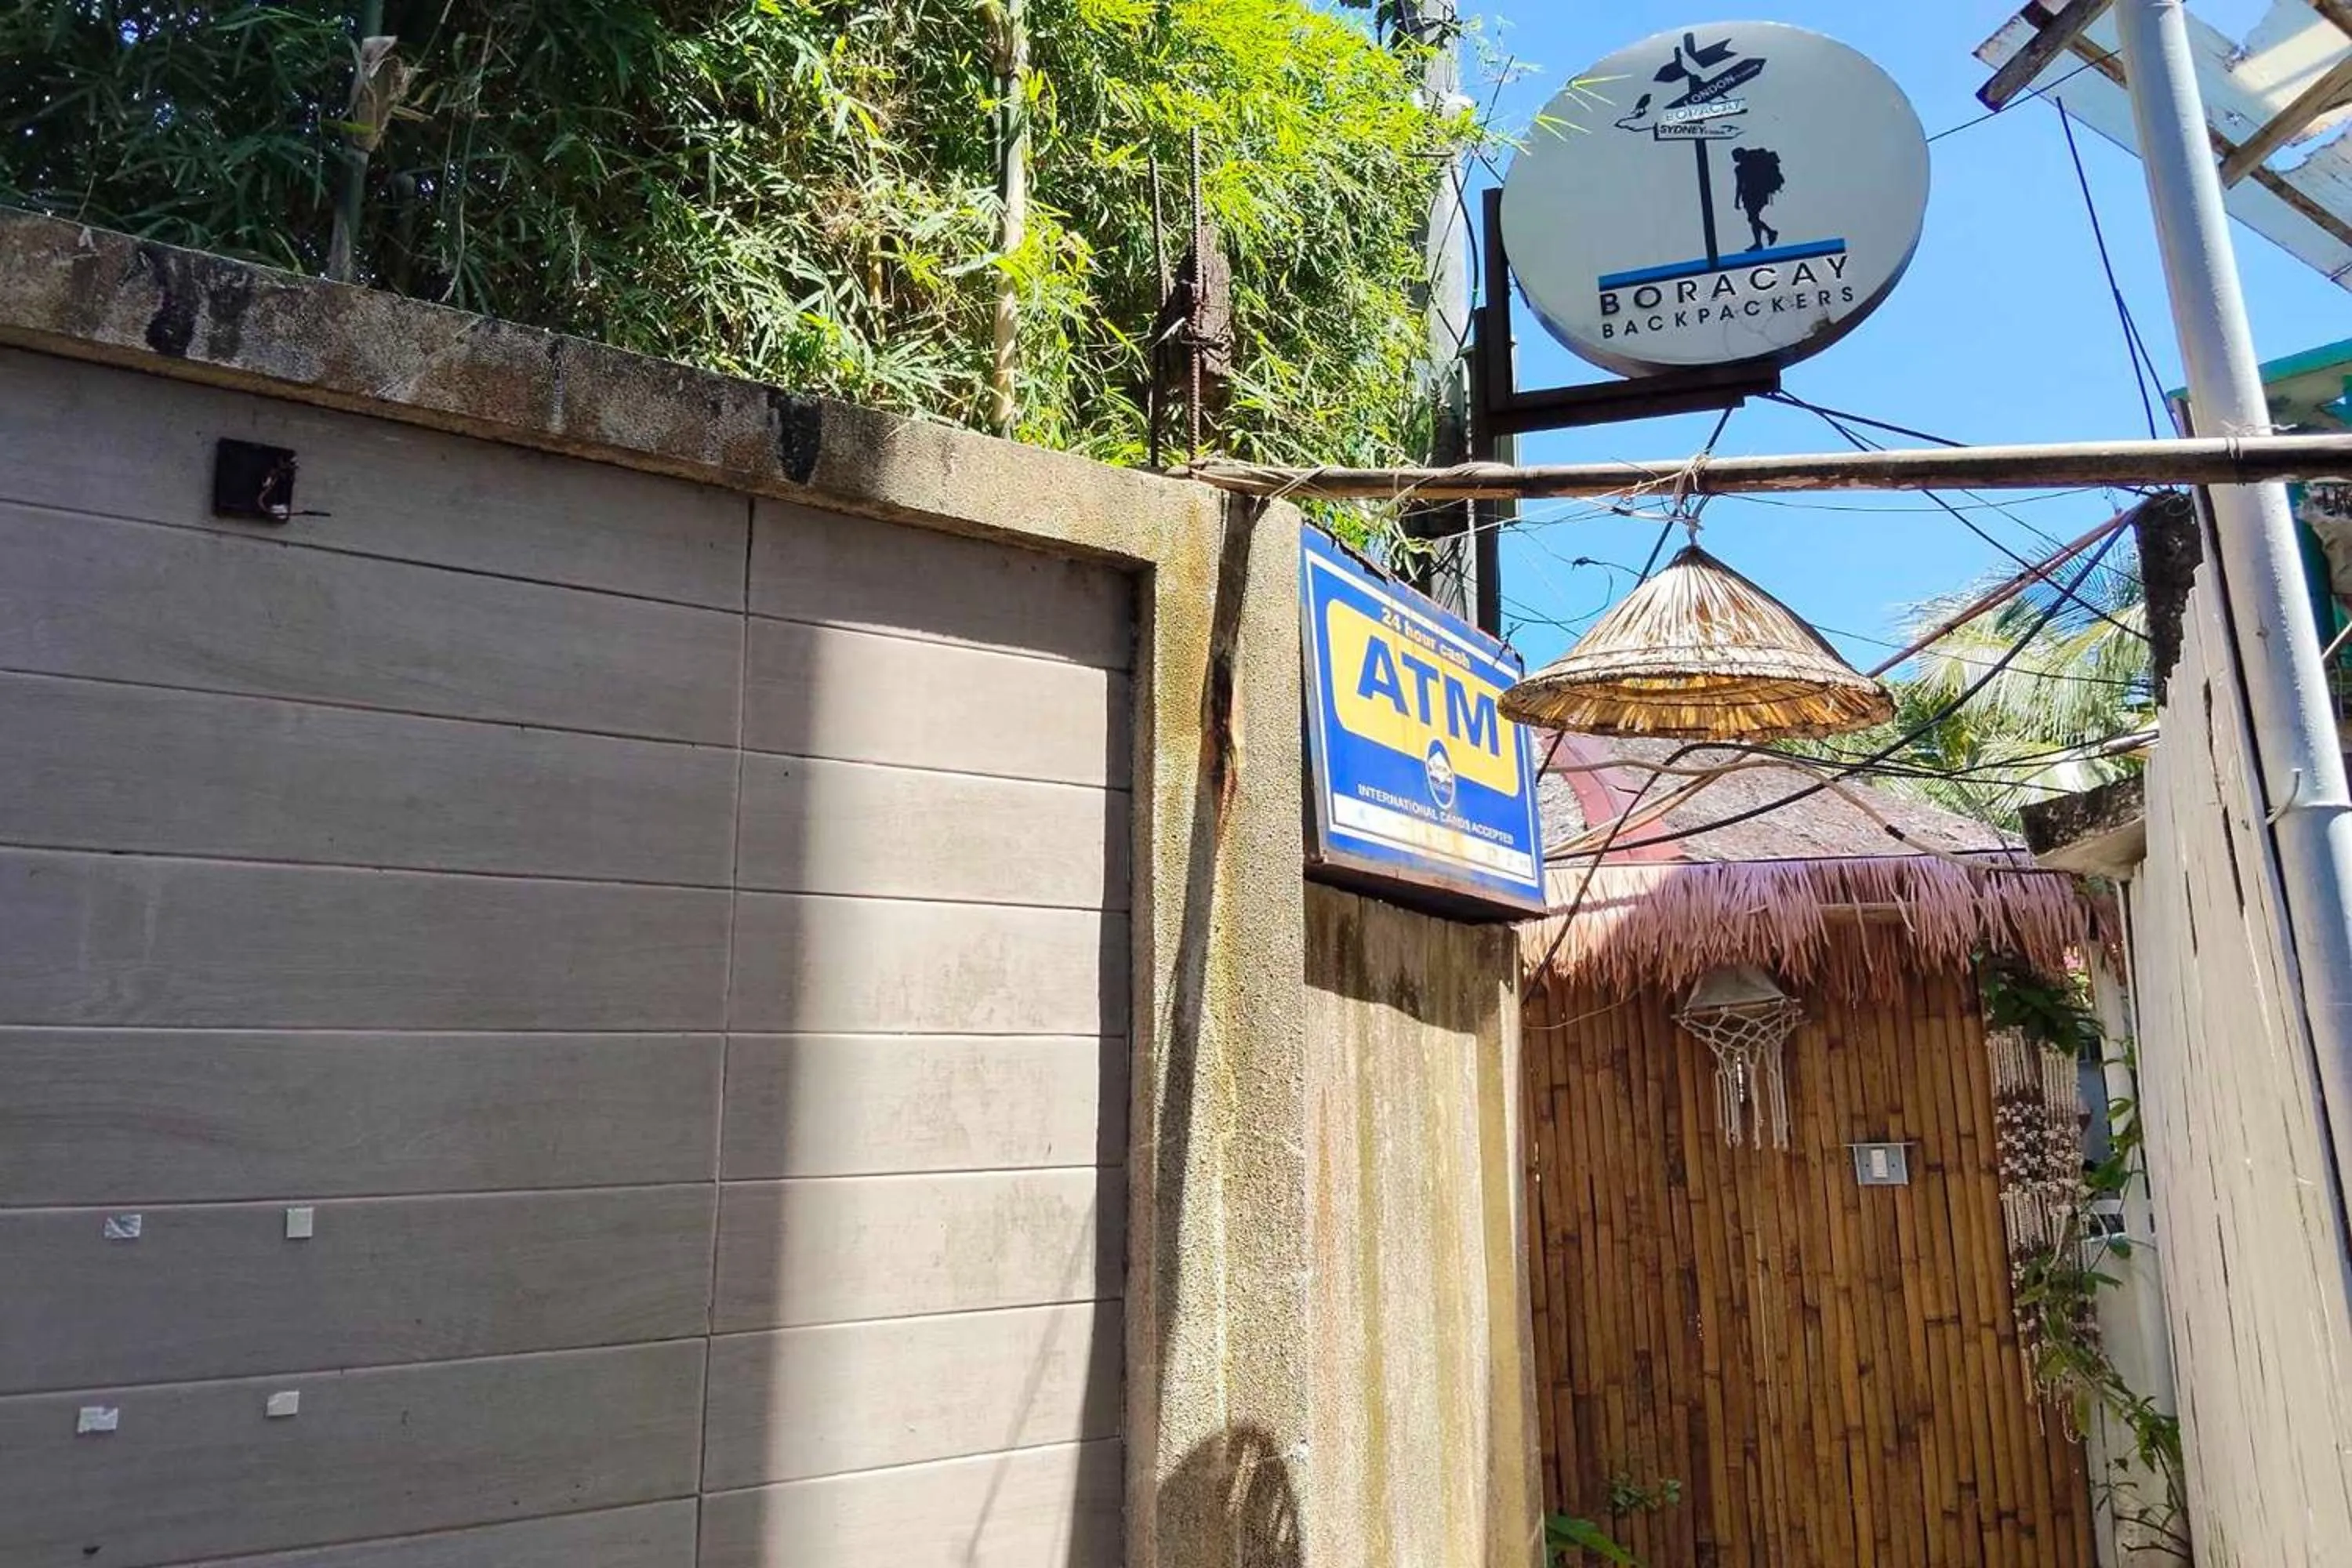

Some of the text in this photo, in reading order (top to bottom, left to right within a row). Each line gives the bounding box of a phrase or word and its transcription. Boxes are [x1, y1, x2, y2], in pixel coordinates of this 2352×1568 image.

[1659, 125, 1706, 136] SYDNEY
[1599, 256, 1848, 315] BORACAY
[1602, 287, 1854, 339] BACKPACKERS
[1381, 605, 1471, 669] 24 hour cash
[1357, 635, 1501, 757] ATM
[1356, 783, 1439, 822] INTERNATIONAL
[1472, 824, 1514, 845] ACCEPTED
